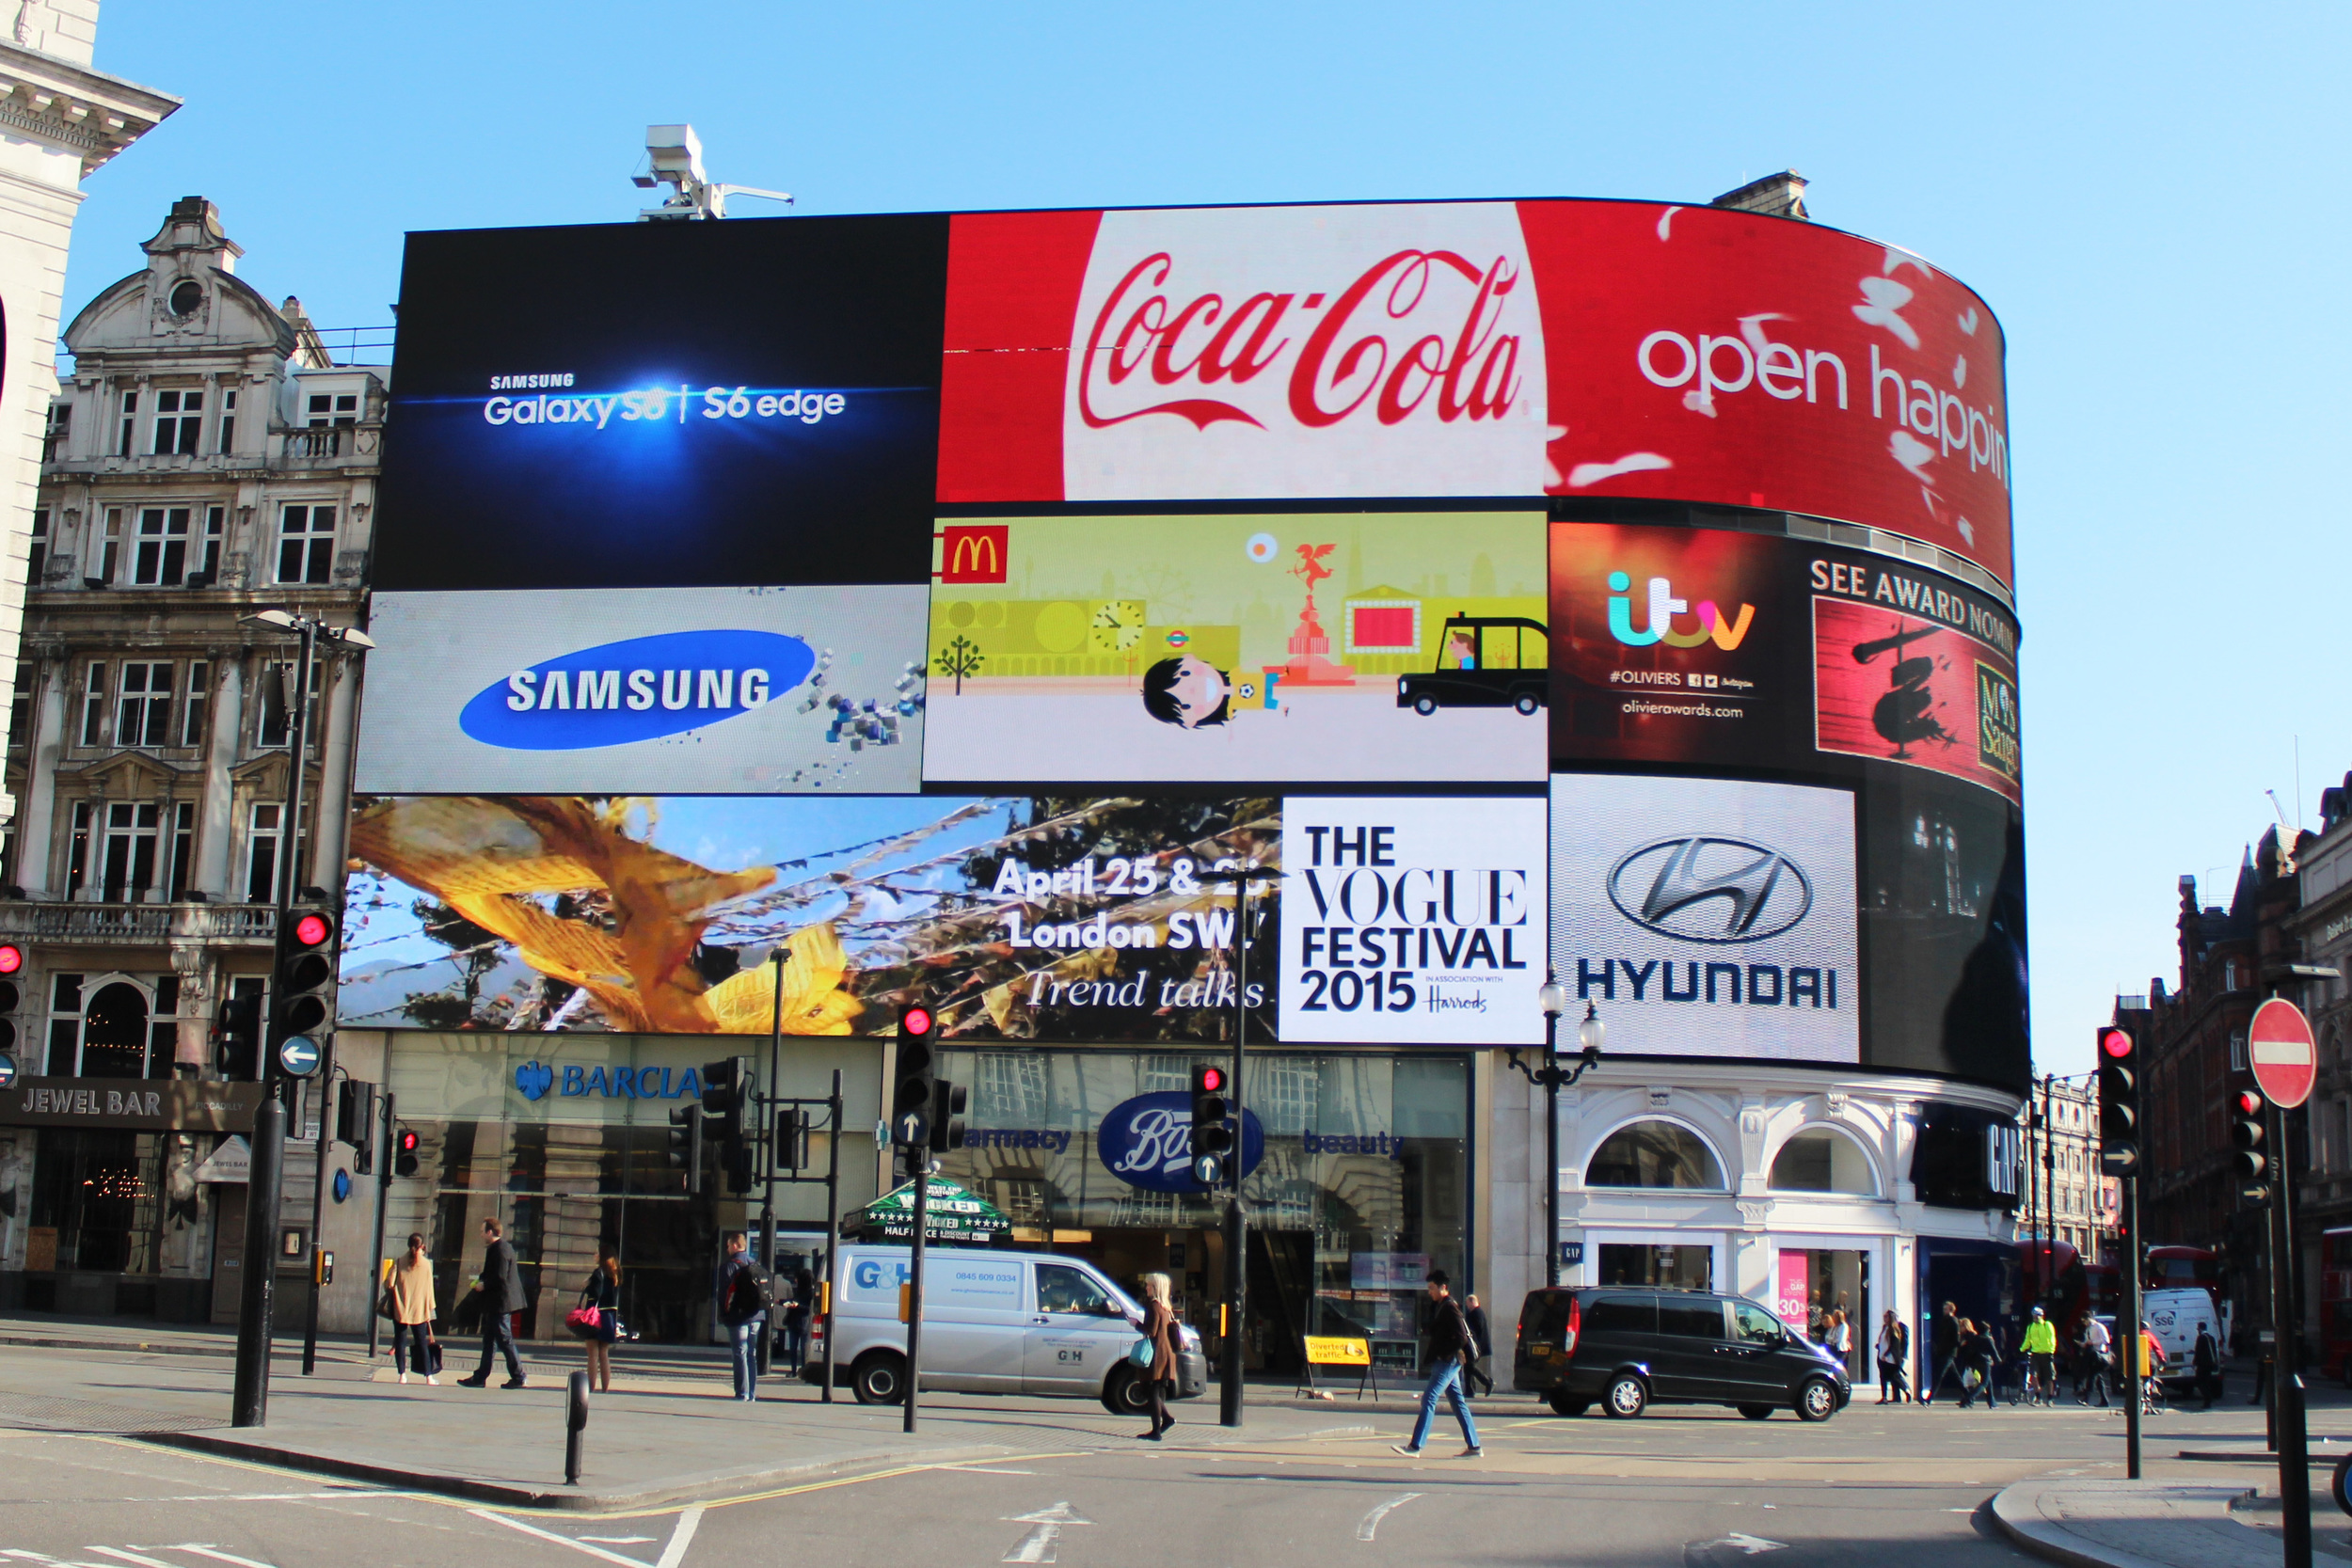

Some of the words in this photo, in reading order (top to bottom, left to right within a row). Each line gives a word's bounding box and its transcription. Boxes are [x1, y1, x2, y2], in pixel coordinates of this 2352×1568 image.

[1078, 248, 1522, 433] Coca-Cola
[490, 372, 574, 390] SAMSUNG
[484, 394, 617, 430] Galaxy
[621, 388, 668, 420] S6
[702, 386, 751, 420] S6
[755, 389, 846, 424] edge
[1638, 330, 1848, 410] open
[1870, 343, 2009, 490] happin
[1607, 571, 1756, 651] itv
[1811, 560, 1867, 597] SEE
[1874, 572, 1966, 626] AWARD
[506, 668, 771, 712] SAMSUNG
[1610, 670, 1682, 686] #OLIVIERS
[1622, 699, 1743, 719] olivierawards.com
[1305, 826, 1395, 866] THE
[993, 857, 1094, 903] April
[1104, 858, 1158, 895] 25
[1169, 858, 1201, 895] &
[1298, 867, 1528, 927] VOGUE
[1009, 911, 1156, 949] London
[1168, 911, 1266, 950] SW
[1302, 927, 1527, 969] FESTIVAL
[1025, 970, 1149, 1007] Trend
[1159, 970, 1264, 1007] talks
[1299, 969, 1417, 1012] 2015
[1422, 985, 1487, 1014] Harrods
[1577, 958, 1837, 1009] HYUNDAI
[560, 1065, 715, 1100] BARCLA
[21, 1088, 101, 1115] JEWEL
[106, 1090, 161, 1117] BAR
[195, 1101, 244, 1111] PICCADILLY
[962, 1129, 1072, 1155] armacy
[1303, 1129, 1405, 1161] beauty
[1987, 1124, 2017, 1196] GAP
[885, 1227, 910, 1236] HALF
[1565, 1247, 1581, 1259] GAP
[956, 1272, 977, 1280] 0845
[978, 1273, 994, 1281] 609
[995, 1274, 1016, 1282] 0334
[2154, 1317, 2175, 1327] SSG
[1310, 1342, 1345, 1351] Diverted
[1315, 1351, 1342, 1359] traffic
